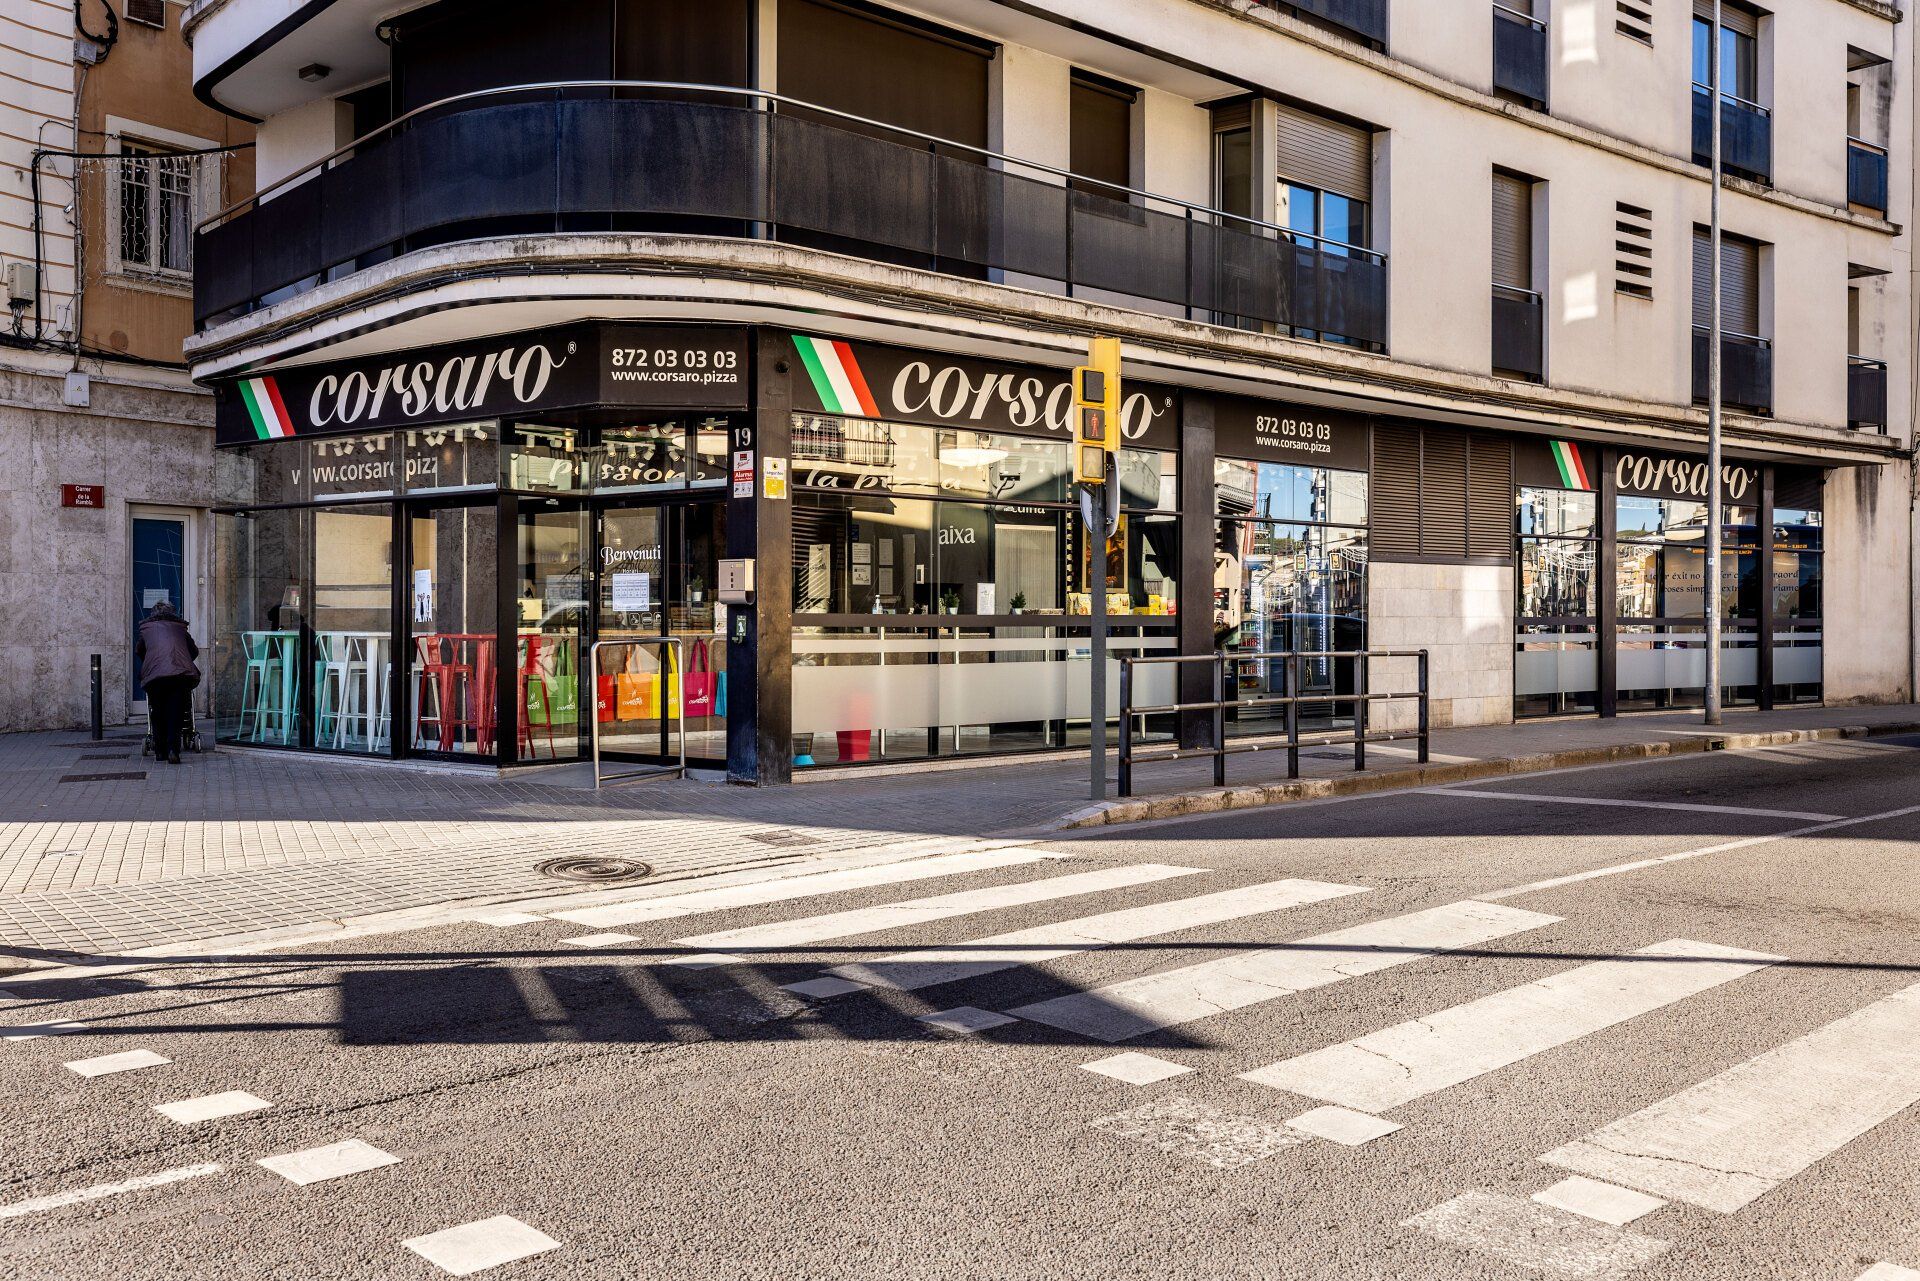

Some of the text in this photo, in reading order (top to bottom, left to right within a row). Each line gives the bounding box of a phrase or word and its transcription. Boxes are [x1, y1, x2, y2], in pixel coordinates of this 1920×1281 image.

[612, 348, 737, 369] 872 03 03 03
[309, 345, 567, 427] corsaro
[611, 370, 738, 386] www.corsaro.pizza
[891, 361, 1165, 440] corsao
[734, 427, 751, 448] 19
[1256, 415, 1331, 440] 872 03 03 03
[1255, 435, 1331, 454] www.corsaro.pizza
[600, 544, 661, 566] Benvenuti
